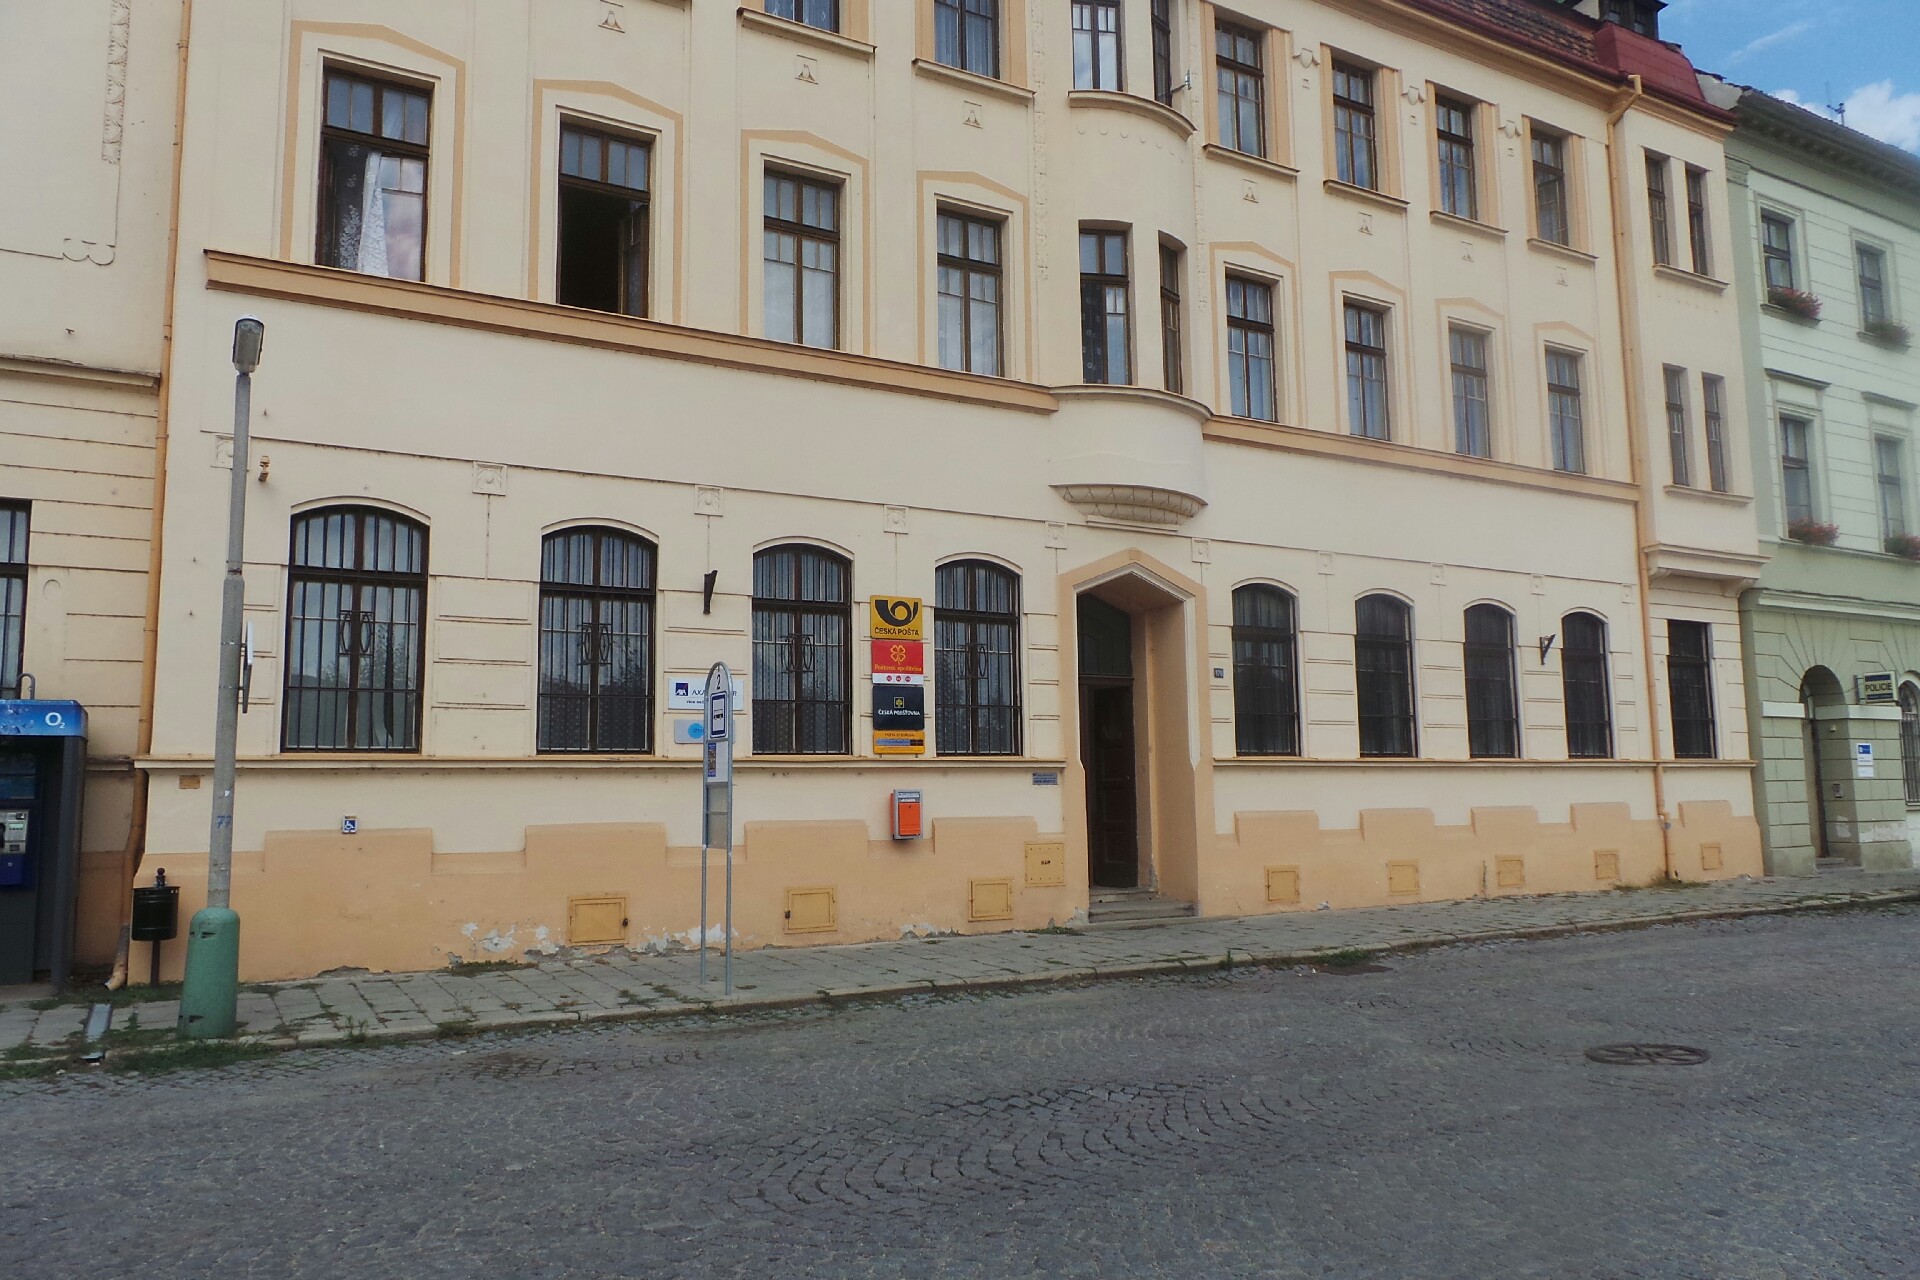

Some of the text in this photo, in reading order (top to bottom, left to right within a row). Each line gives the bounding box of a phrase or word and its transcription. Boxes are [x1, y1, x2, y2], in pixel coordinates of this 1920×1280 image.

[874, 627, 920, 636] ČESKÁ POŠTA
[716, 673, 721, 690] 2
[1865, 683, 1893, 692] POLICIE
